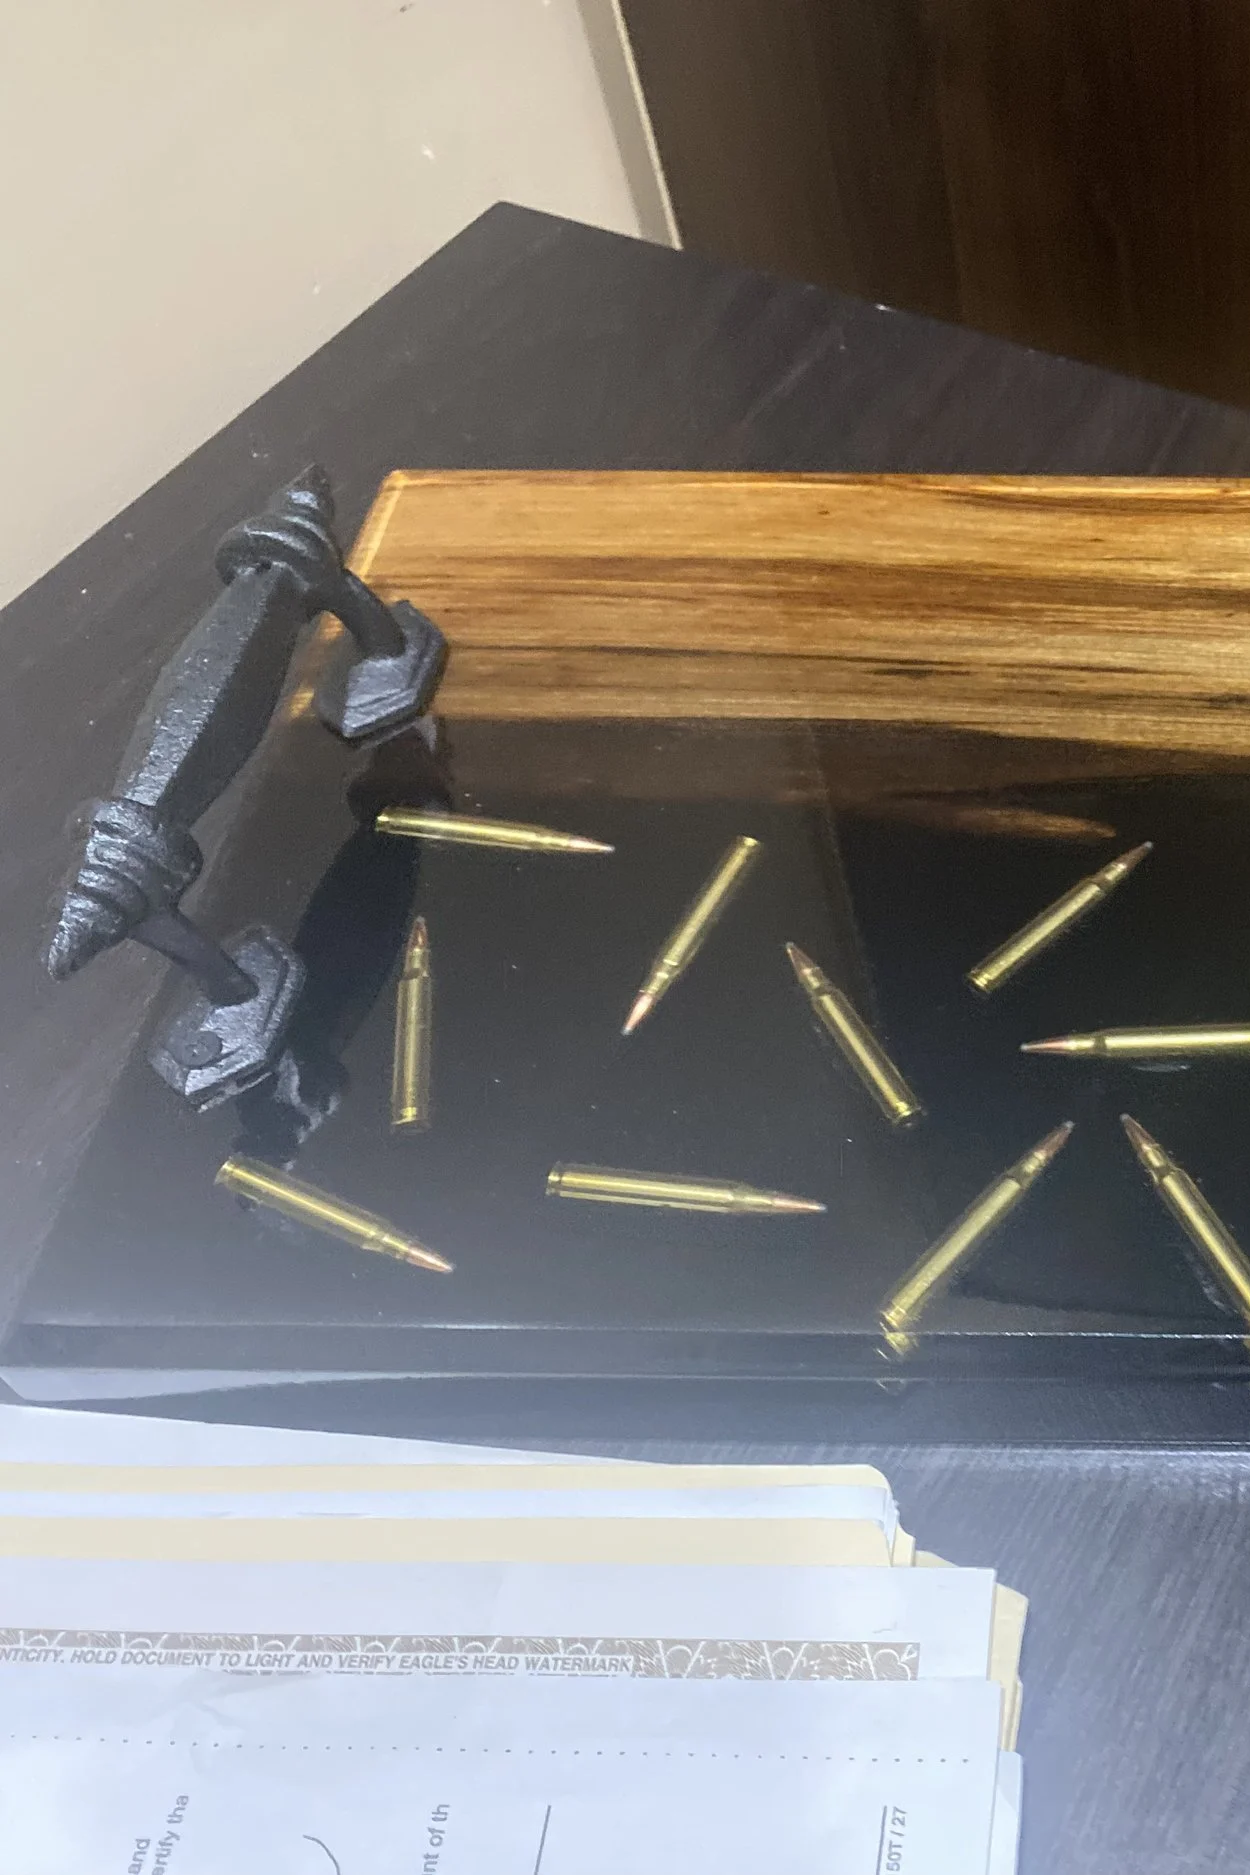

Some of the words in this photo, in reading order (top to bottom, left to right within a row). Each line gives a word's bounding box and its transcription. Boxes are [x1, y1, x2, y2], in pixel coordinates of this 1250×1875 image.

[0, 1648, 65, 1663] NTICITY.
[70, 1649, 116, 1665] HOLD
[120, 1651, 214, 1667] DOCUMENT
[219, 1652, 242, 1667] TO
[245, 1653, 295, 1668] LIGHT
[296, 1653, 332, 1669] AND
[339, 1654, 396, 1669] VERIFY
[398, 1655, 468, 1670] EAGLE'S
[472, 1656, 519, 1671] HEAD
[525, 1656, 632, 1672] WATERMARK
[166, 1795, 189, 1824] tha
[431, 1804, 451, 1822] th
[891, 1806, 908, 1827] 27
[427, 1827, 446, 1847] of
[127, 1838, 151, 1875] and
[422, 1853, 440, 1875] nt
